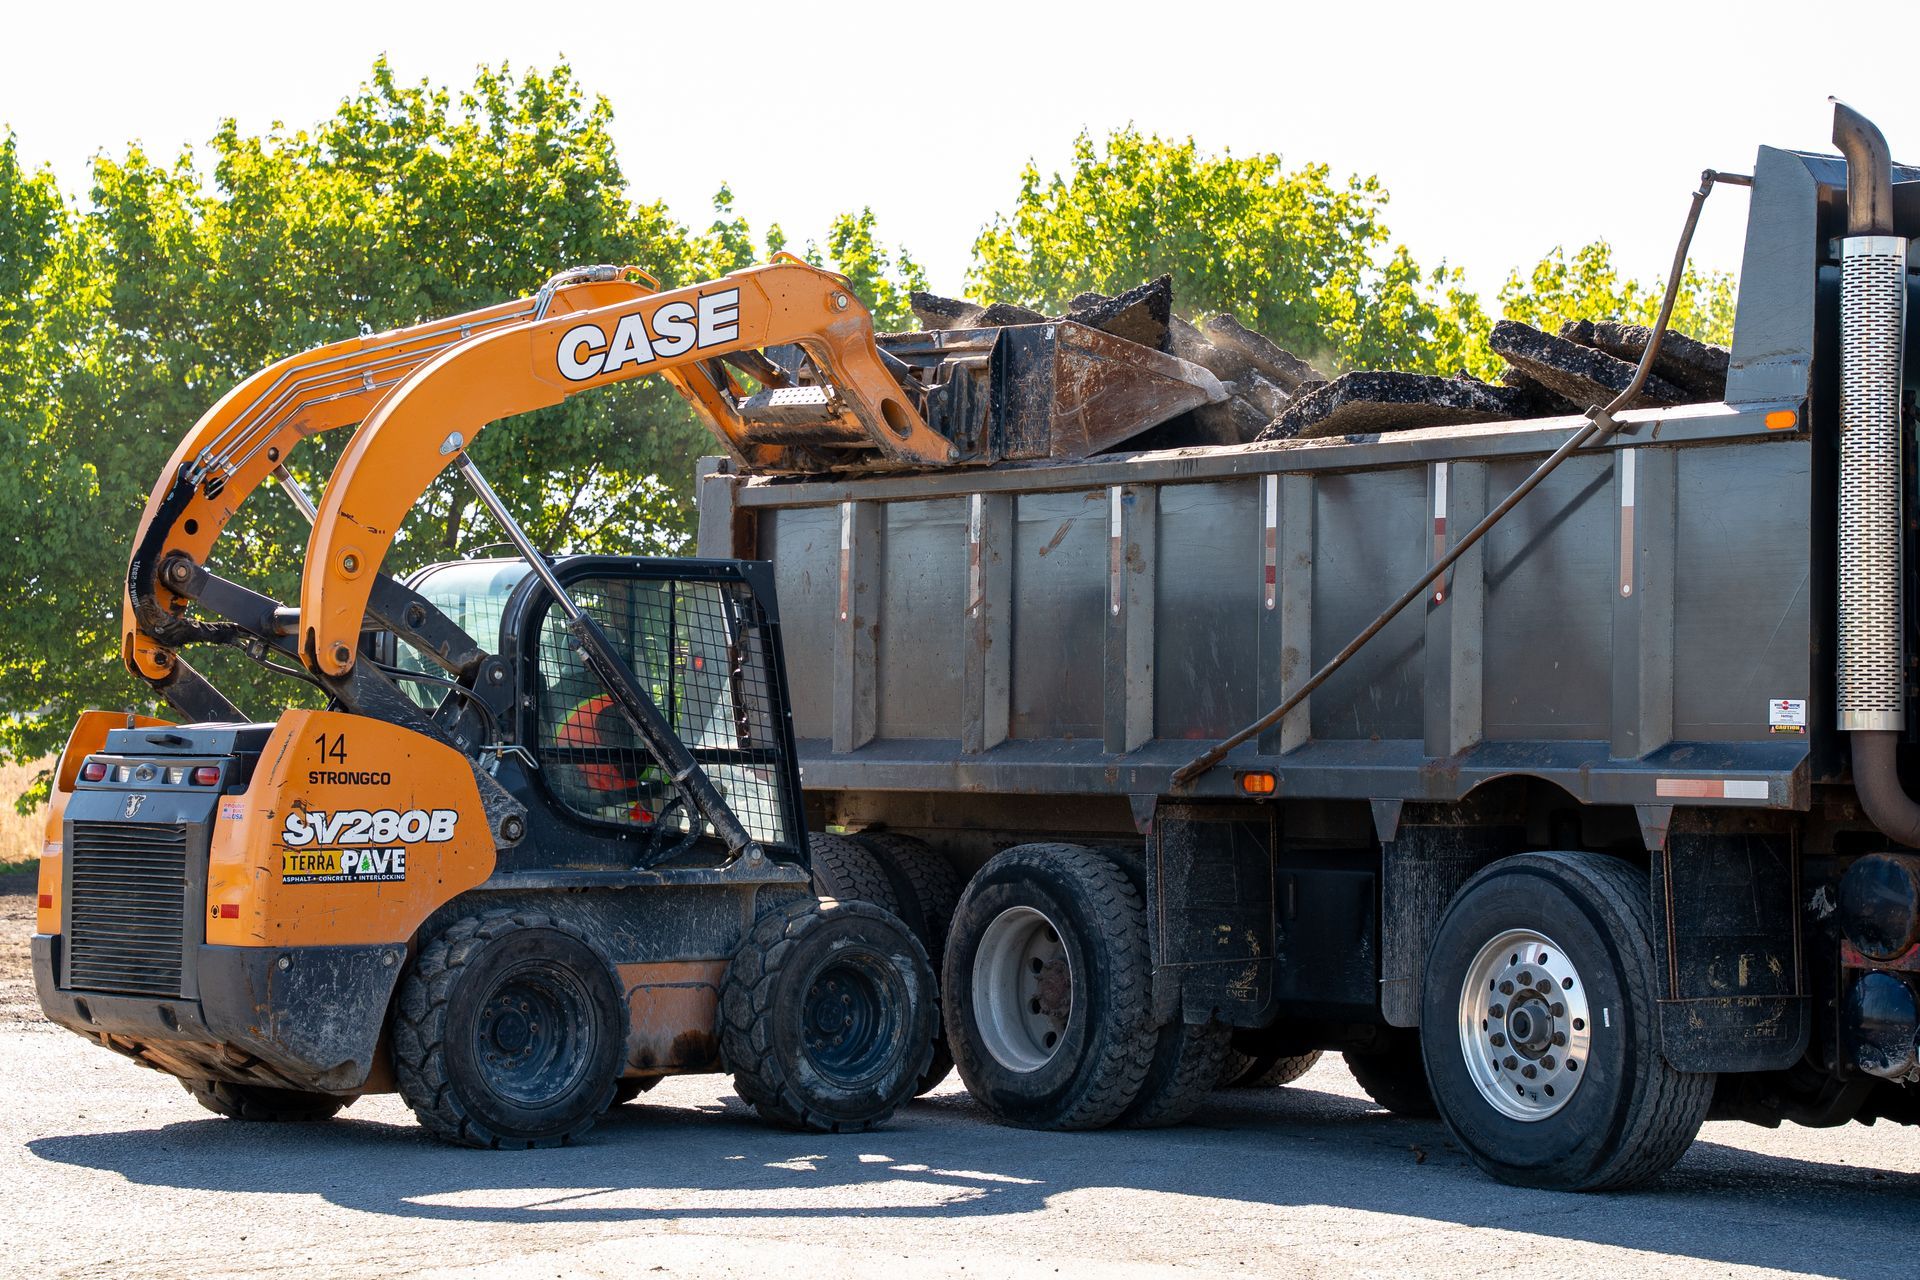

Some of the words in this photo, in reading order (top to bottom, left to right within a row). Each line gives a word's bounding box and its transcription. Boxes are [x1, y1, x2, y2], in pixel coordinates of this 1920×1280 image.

[557, 288, 739, 381] CASE
[315, 733, 347, 764] 14
[308, 771, 391, 785] STRONGCO
[282, 809, 458, 846] SV280B
[290, 855, 335, 871] TERRA
[342, 849, 405, 873] PAVE
